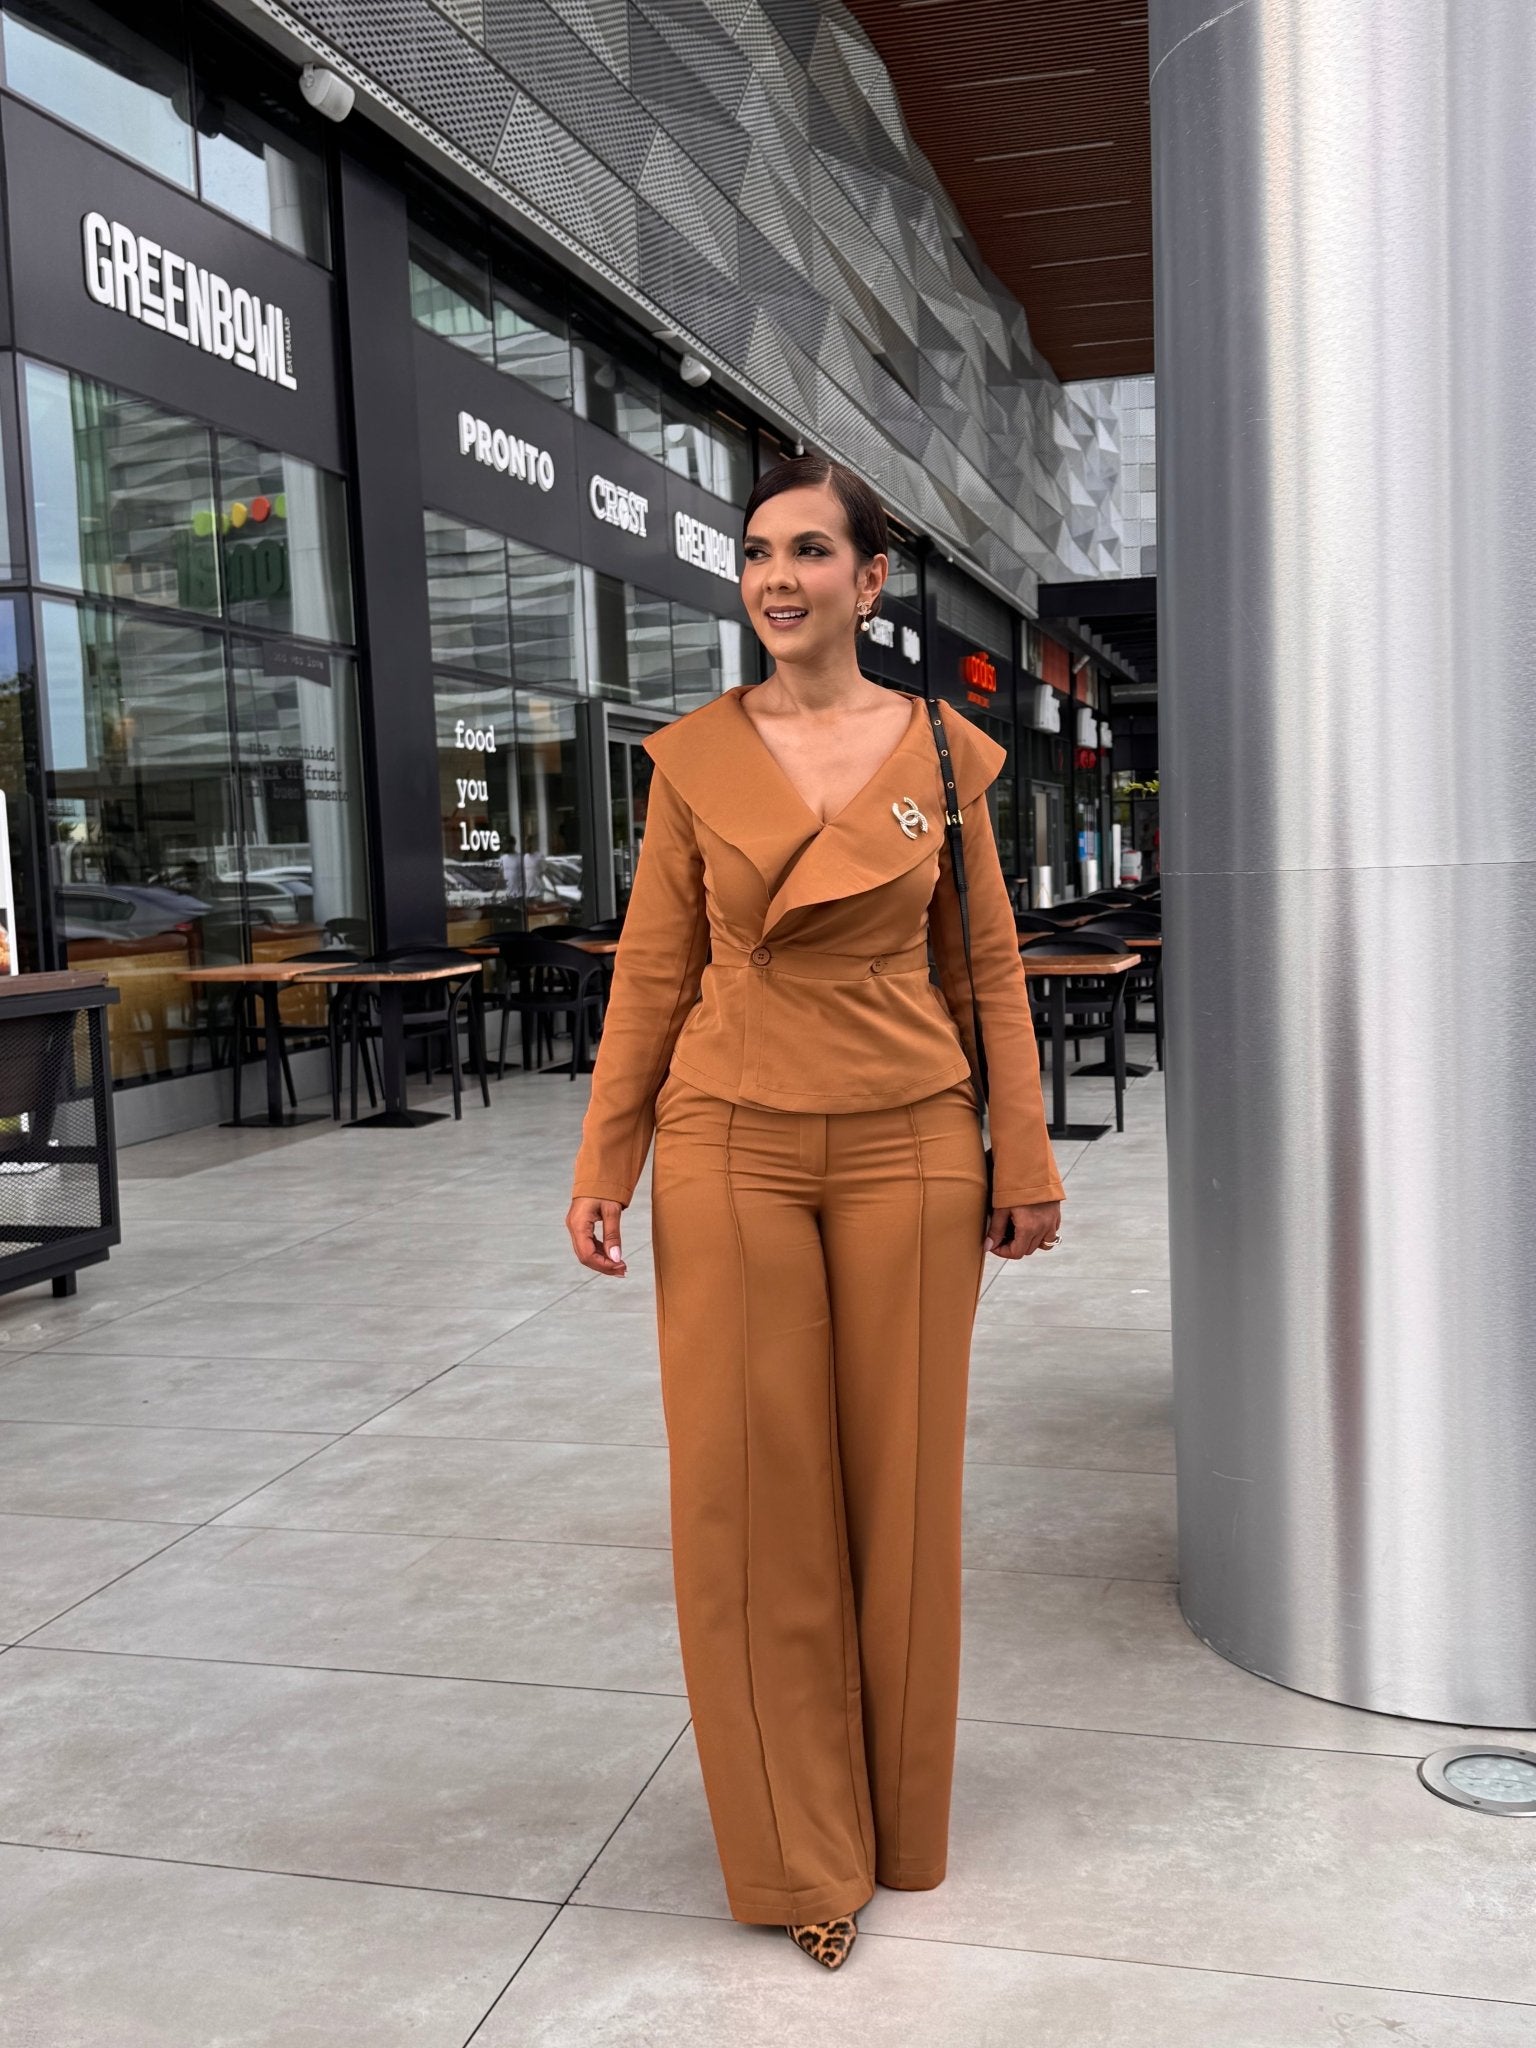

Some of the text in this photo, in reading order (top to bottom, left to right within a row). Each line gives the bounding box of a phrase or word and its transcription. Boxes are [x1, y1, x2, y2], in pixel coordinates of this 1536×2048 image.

[82, 212, 297, 390] GREENBOWL
[459, 411, 554, 491] PRONTO
[675, 511, 739, 583] GREENBOWL
[455, 719, 496, 753] food
[455, 778, 489, 808] you
[459, 821, 501, 851] love
